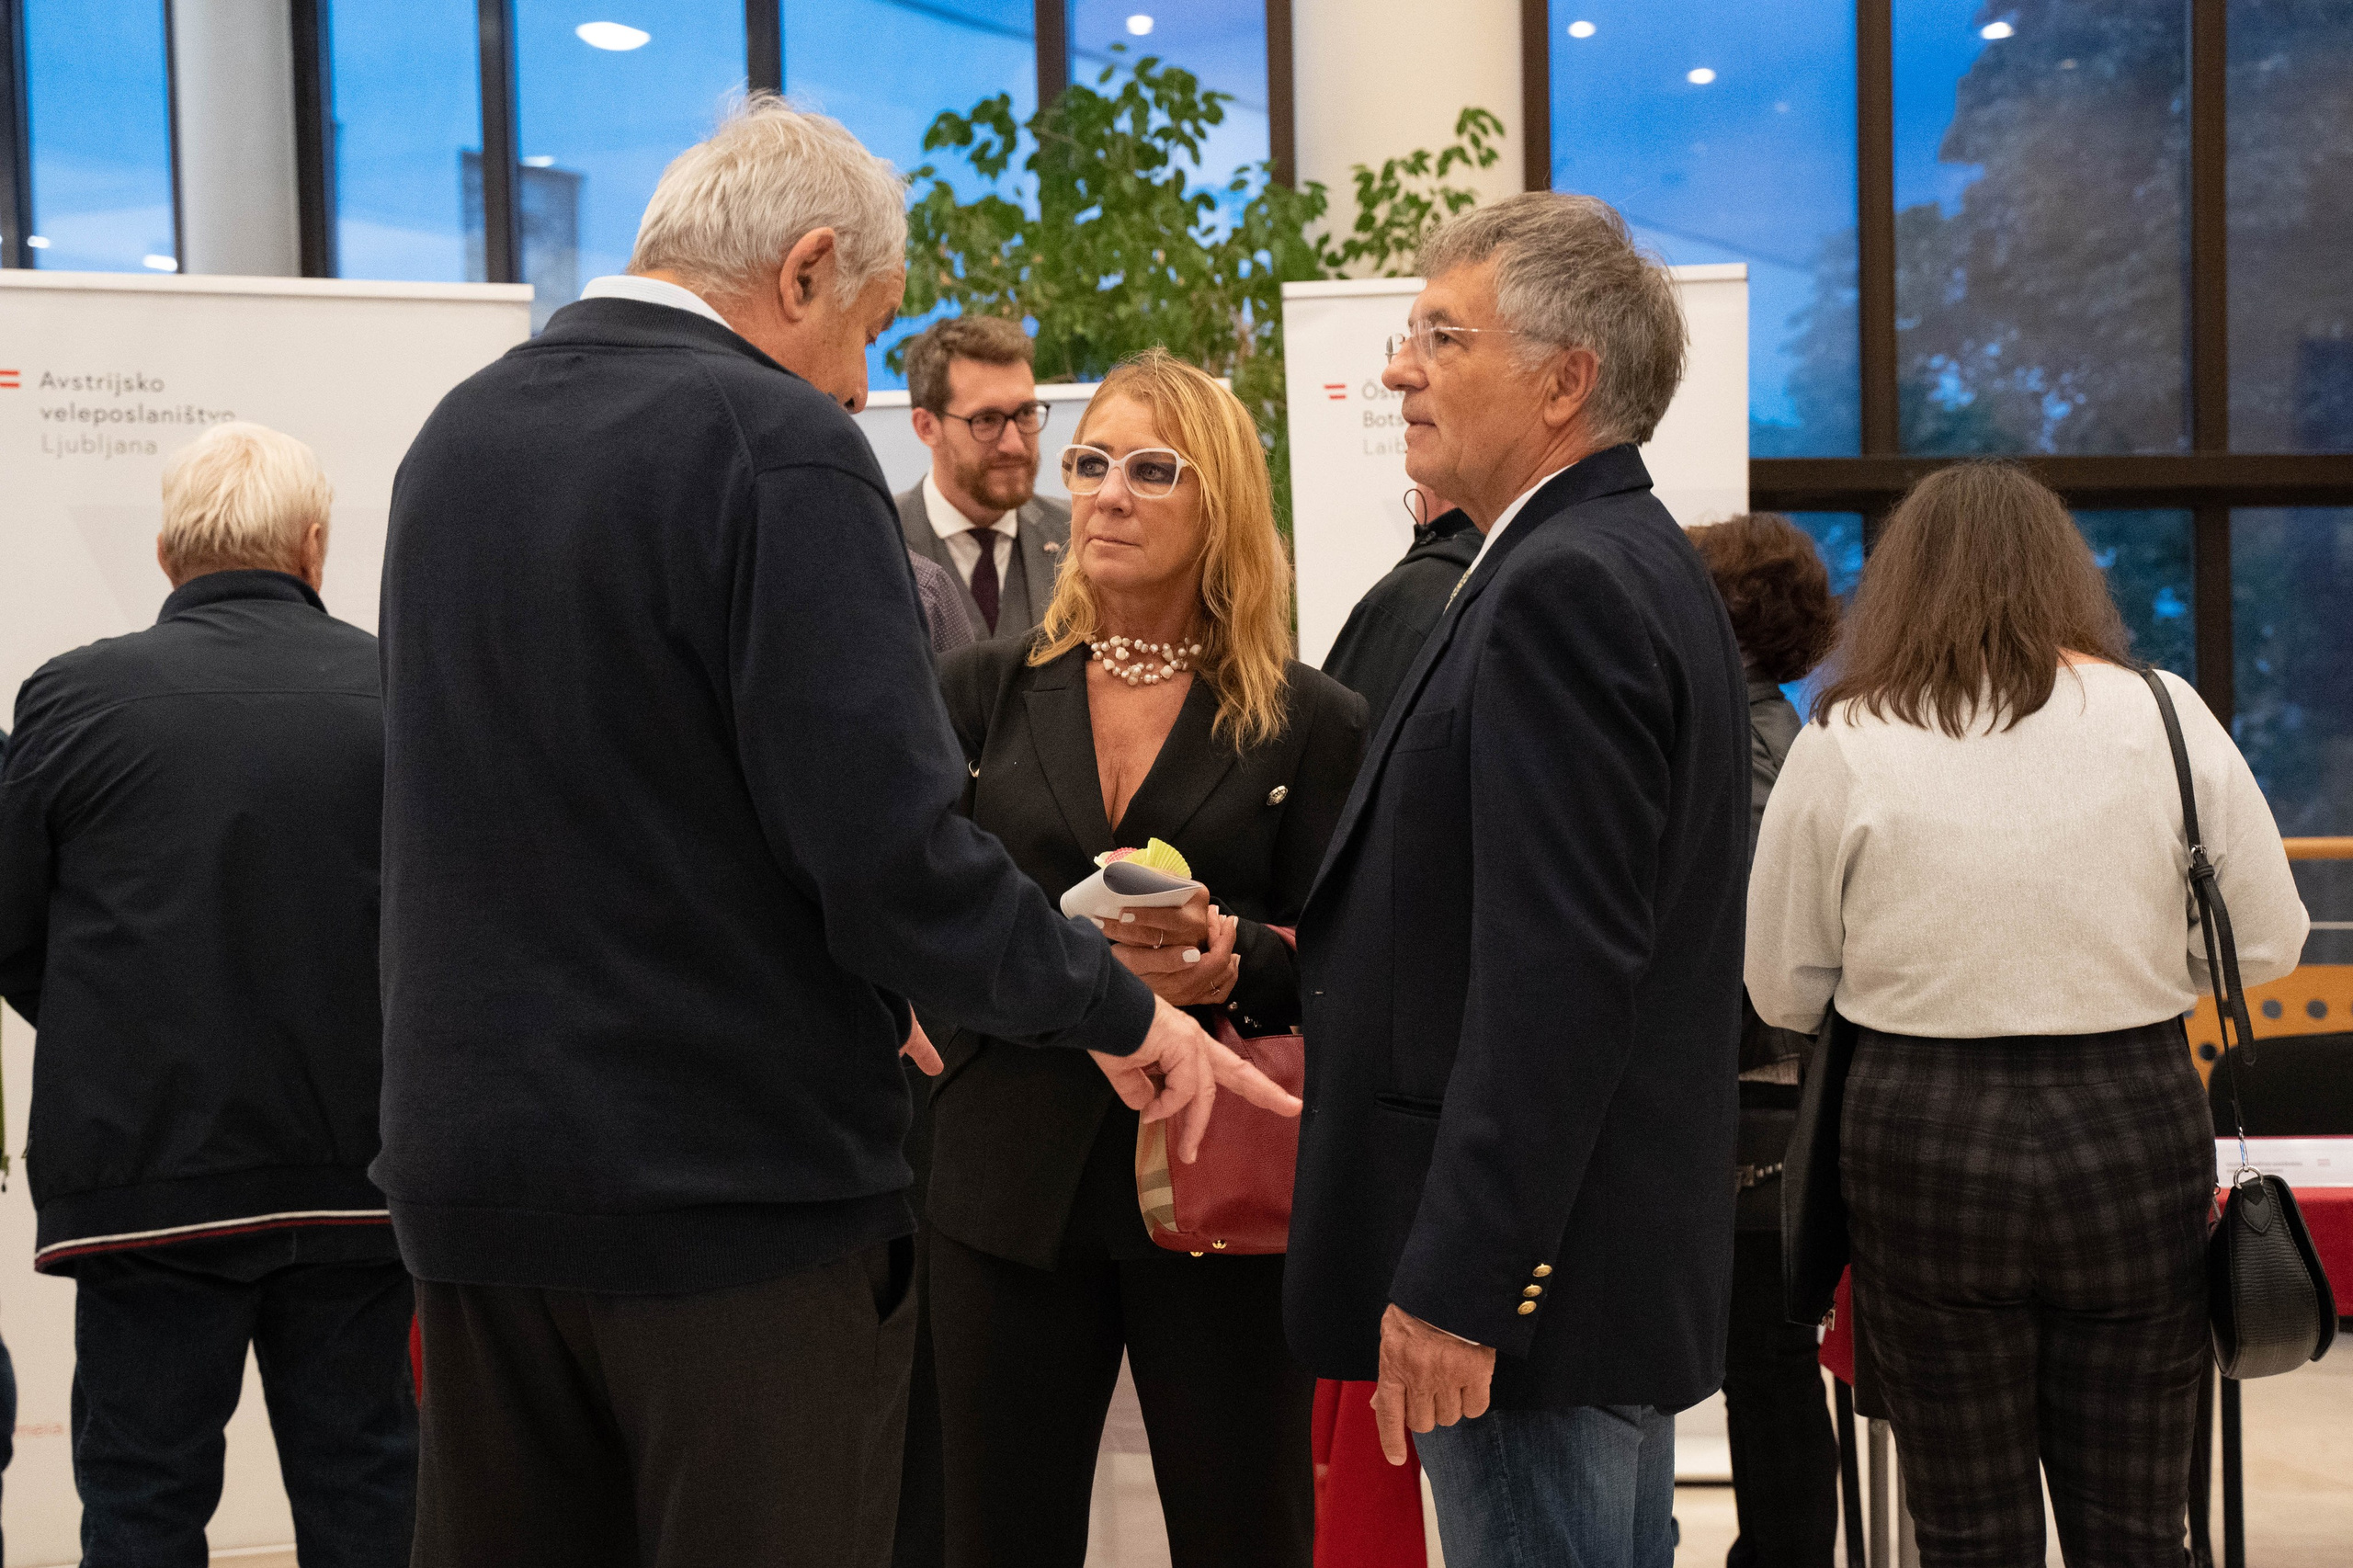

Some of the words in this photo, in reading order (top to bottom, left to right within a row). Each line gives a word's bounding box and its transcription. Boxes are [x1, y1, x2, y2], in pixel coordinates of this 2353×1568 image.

[40, 370, 165, 396] Avstrijsko
[40, 402, 236, 426] veleposlaništvo
[40, 432, 158, 460] Ljubljana
